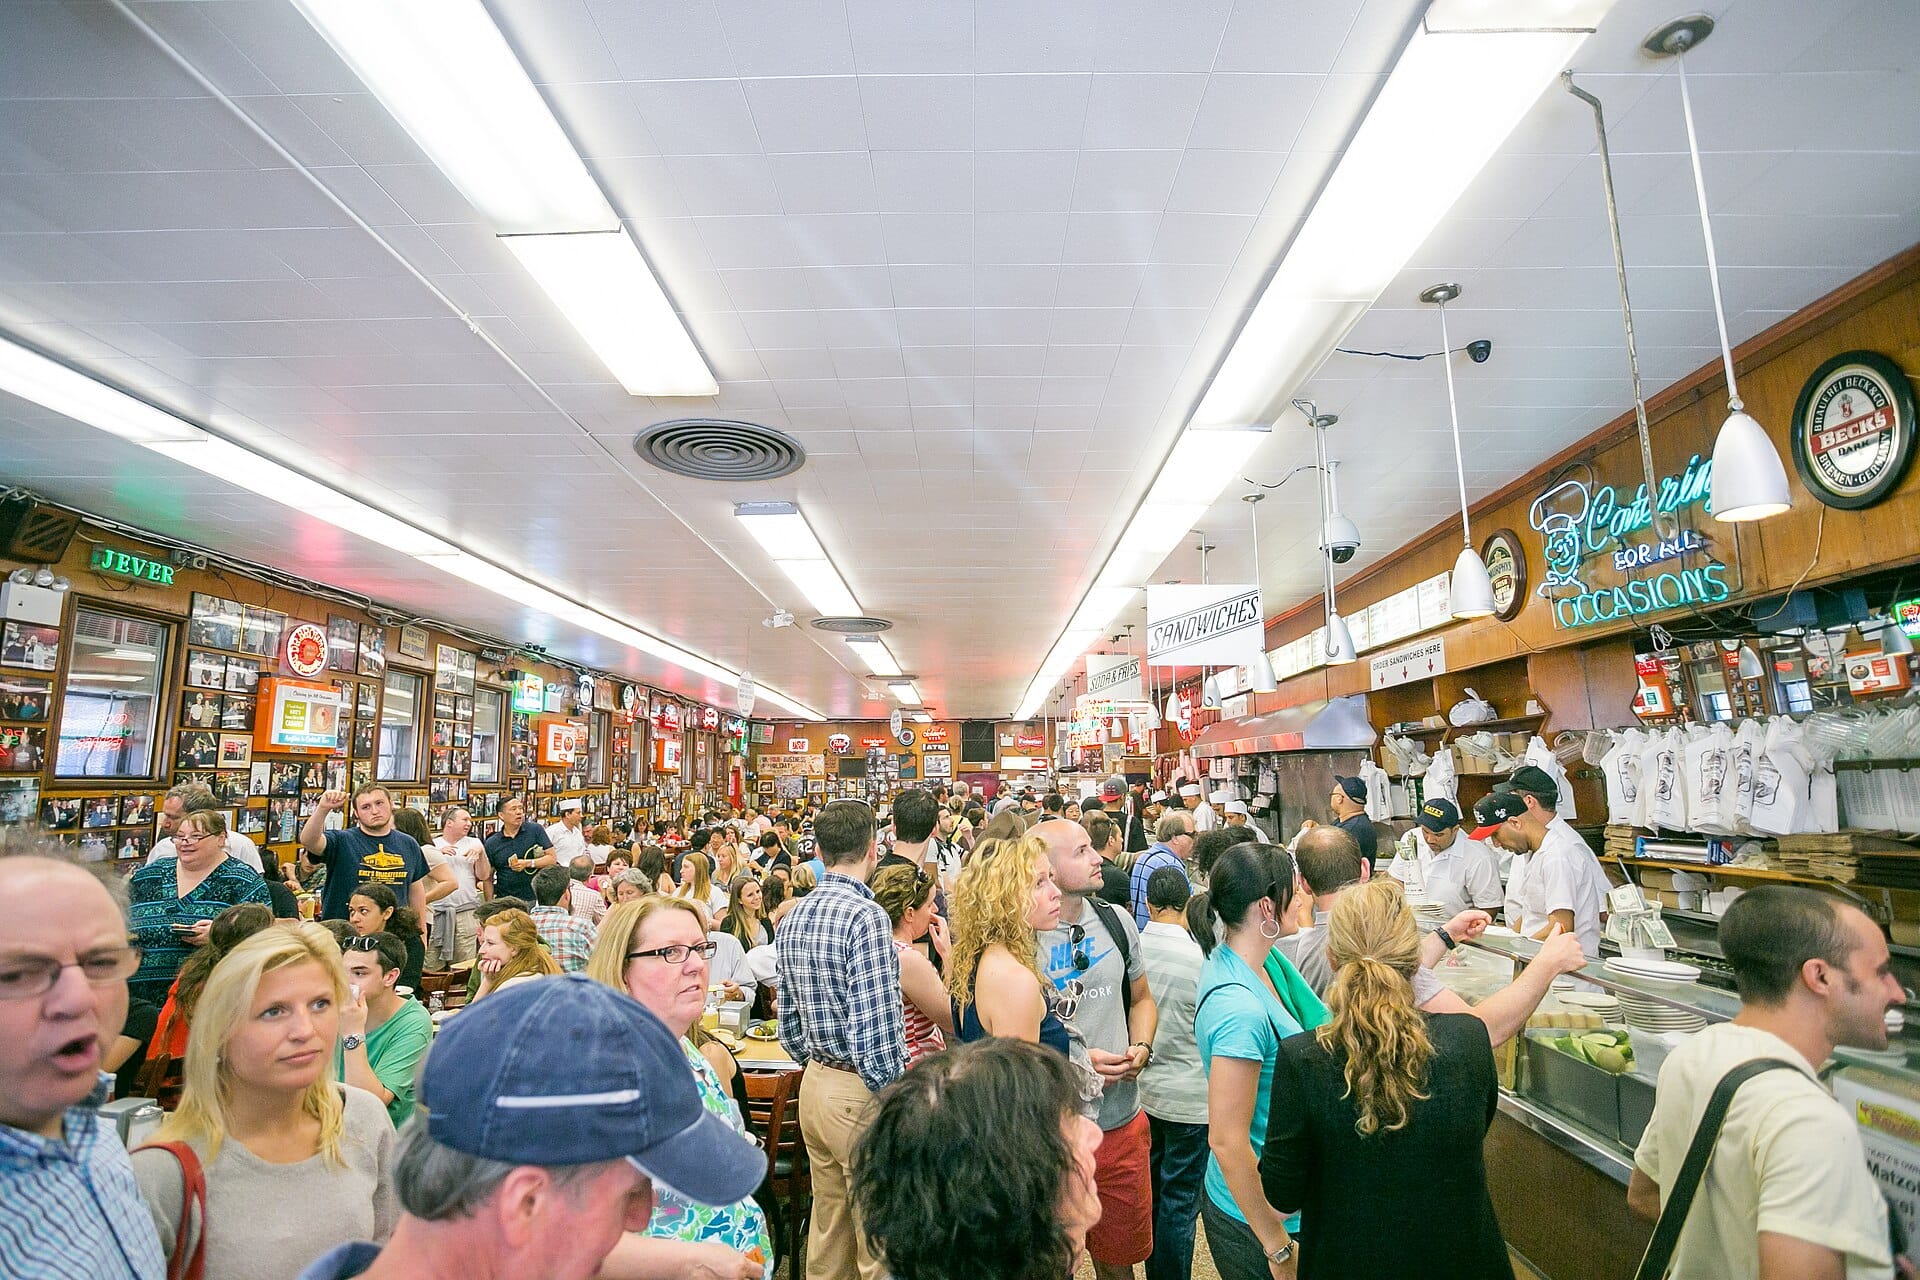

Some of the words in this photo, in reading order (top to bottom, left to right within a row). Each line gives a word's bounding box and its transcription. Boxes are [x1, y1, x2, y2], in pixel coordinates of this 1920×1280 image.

[1813, 381, 1842, 432] BRAUEREI
[1819, 453, 1853, 486] BREMEN
[1858, 432, 1891, 484] GERMANY
[1837, 439, 1870, 457] DARK
[101, 549, 175, 585] JEVER
[1614, 543, 1651, 570] FOR
[1659, 530, 1699, 559] ALL
[1557, 565, 1729, 628] OCCASIONS
[1150, 596, 1259, 652] SANDWICHES
[1373, 660, 1389, 671] ORDER
[1389, 649, 1424, 666] SANDWICHES
[1425, 643, 1441, 656] HERE
[1090, 672, 1111, 692] SODA
[1117, 661, 1139, 681] FRIES
[1050, 936, 1096, 971] NIE
[1082, 985, 1112, 999] YORK
